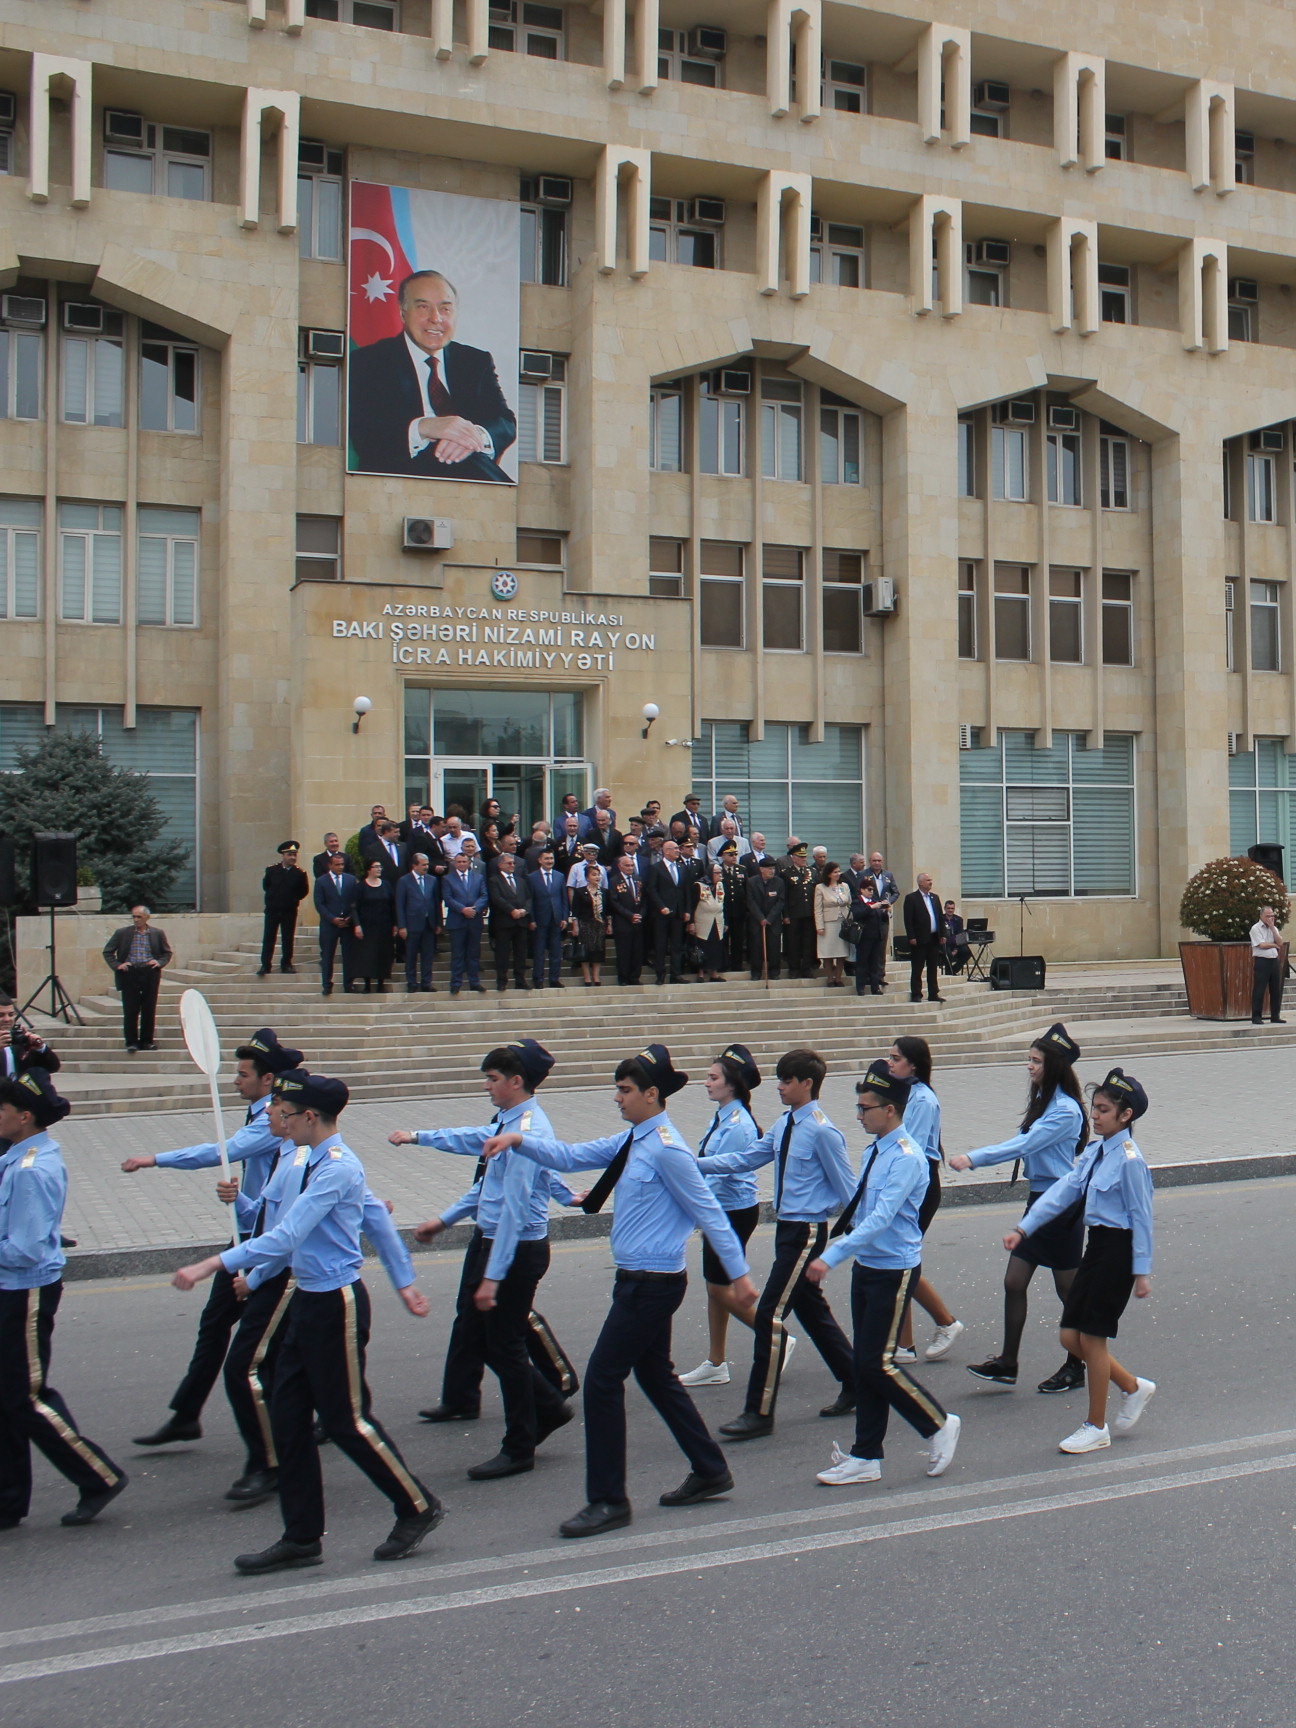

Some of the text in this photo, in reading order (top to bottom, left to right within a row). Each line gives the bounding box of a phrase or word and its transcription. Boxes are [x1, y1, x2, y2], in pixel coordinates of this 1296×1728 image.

[382, 604, 623, 626] AZƏRBAYCAN RESPUBLİKASI
[332, 620, 655, 650] BAKI ŞƏHƏRİ NİZAMİ RAYON
[392, 642, 614, 671] İCRA HAKİMİYYƏTİ
